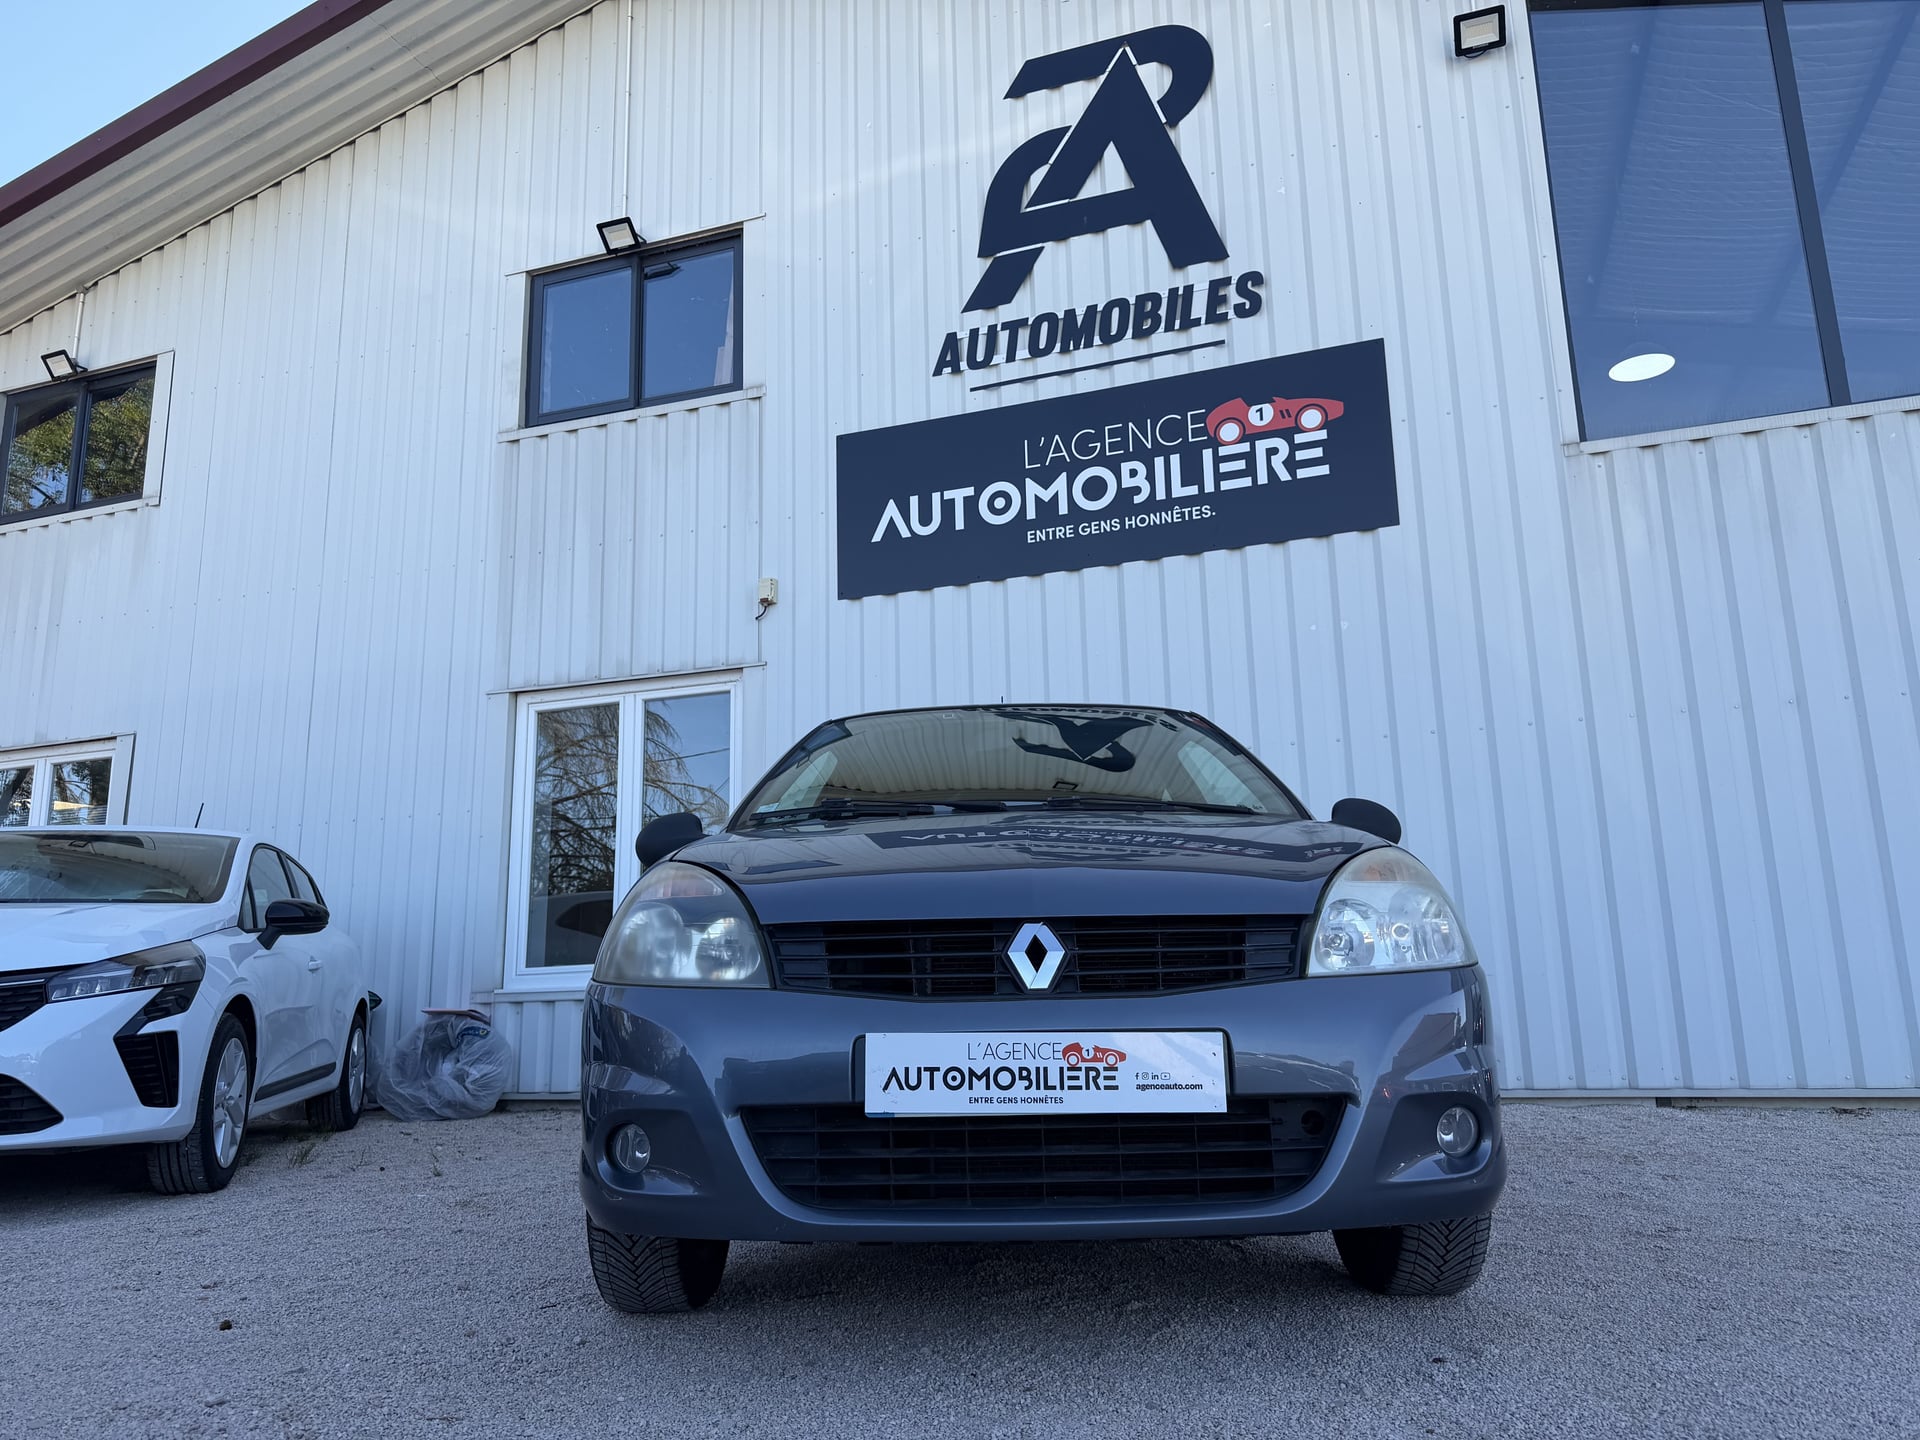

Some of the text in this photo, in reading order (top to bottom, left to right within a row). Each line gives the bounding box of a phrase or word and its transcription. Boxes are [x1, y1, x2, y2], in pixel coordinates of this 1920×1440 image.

[932, 270, 1265, 377] AUTOMOBILES
[1254, 407, 1265, 422] 1
[1023, 408, 1208, 469] L'AGENCE
[1026, 505, 1216, 543] ENTRE GENS HONNÊTES.
[967, 1042, 1063, 1061] L'AGENCE
[1135, 1082, 1204, 1092] agenceauto.com
[968, 1094, 1064, 1105] ENTRE GENS HONNÊTES
